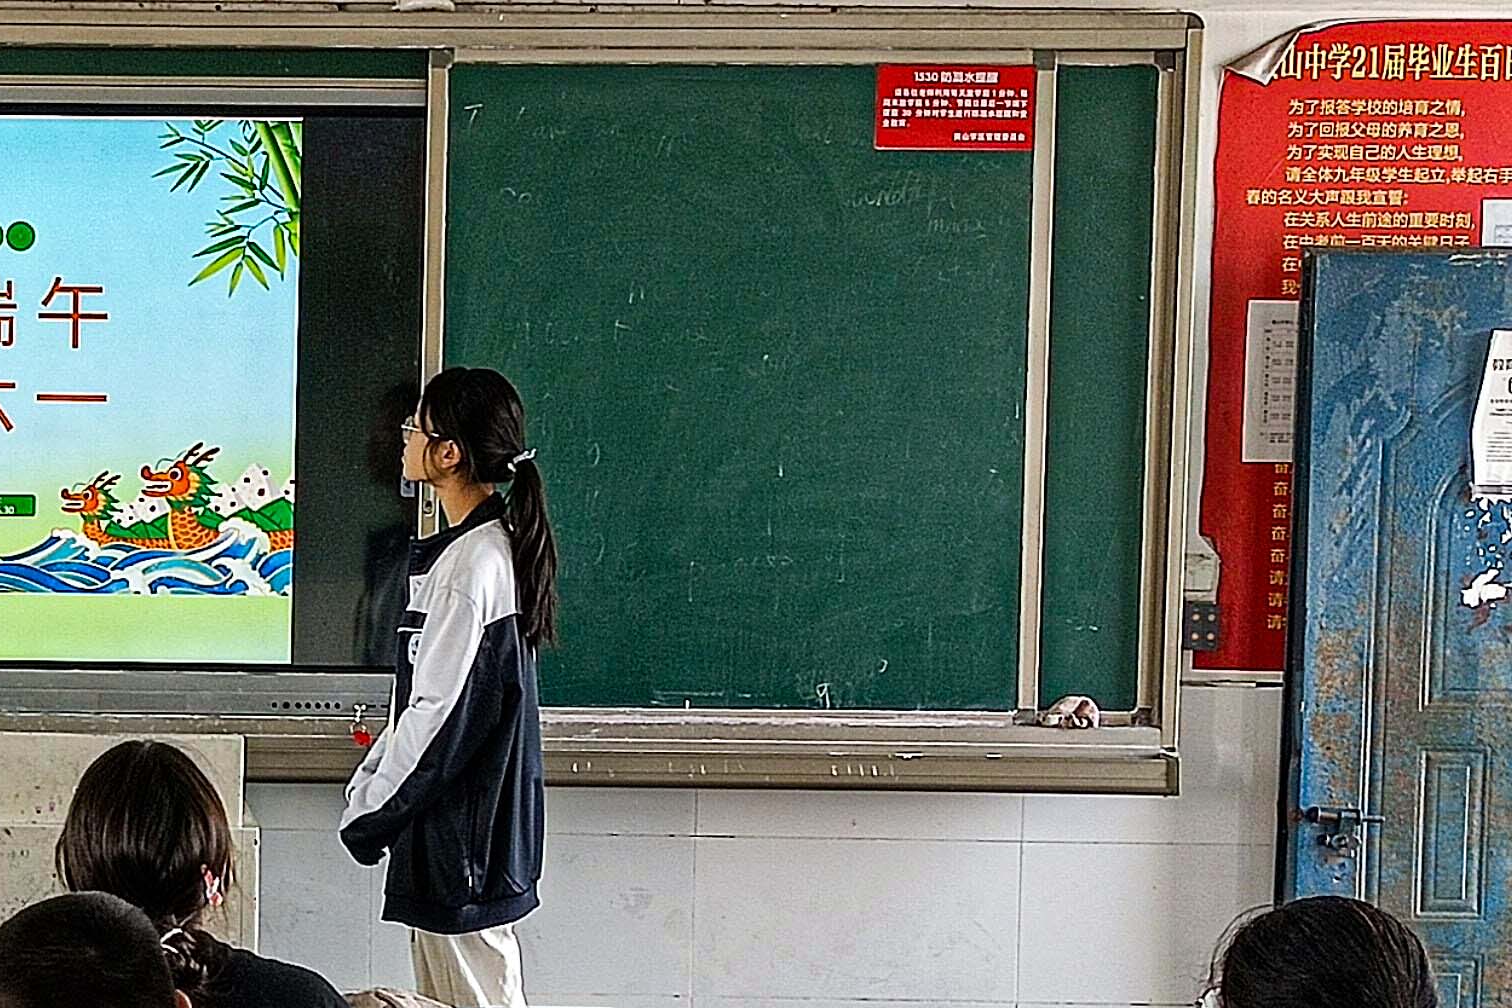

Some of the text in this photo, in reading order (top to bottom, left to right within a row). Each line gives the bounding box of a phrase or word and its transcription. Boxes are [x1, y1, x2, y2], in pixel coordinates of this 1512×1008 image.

[1271, 43, 1512, 80] 山中学21届毕业生百
